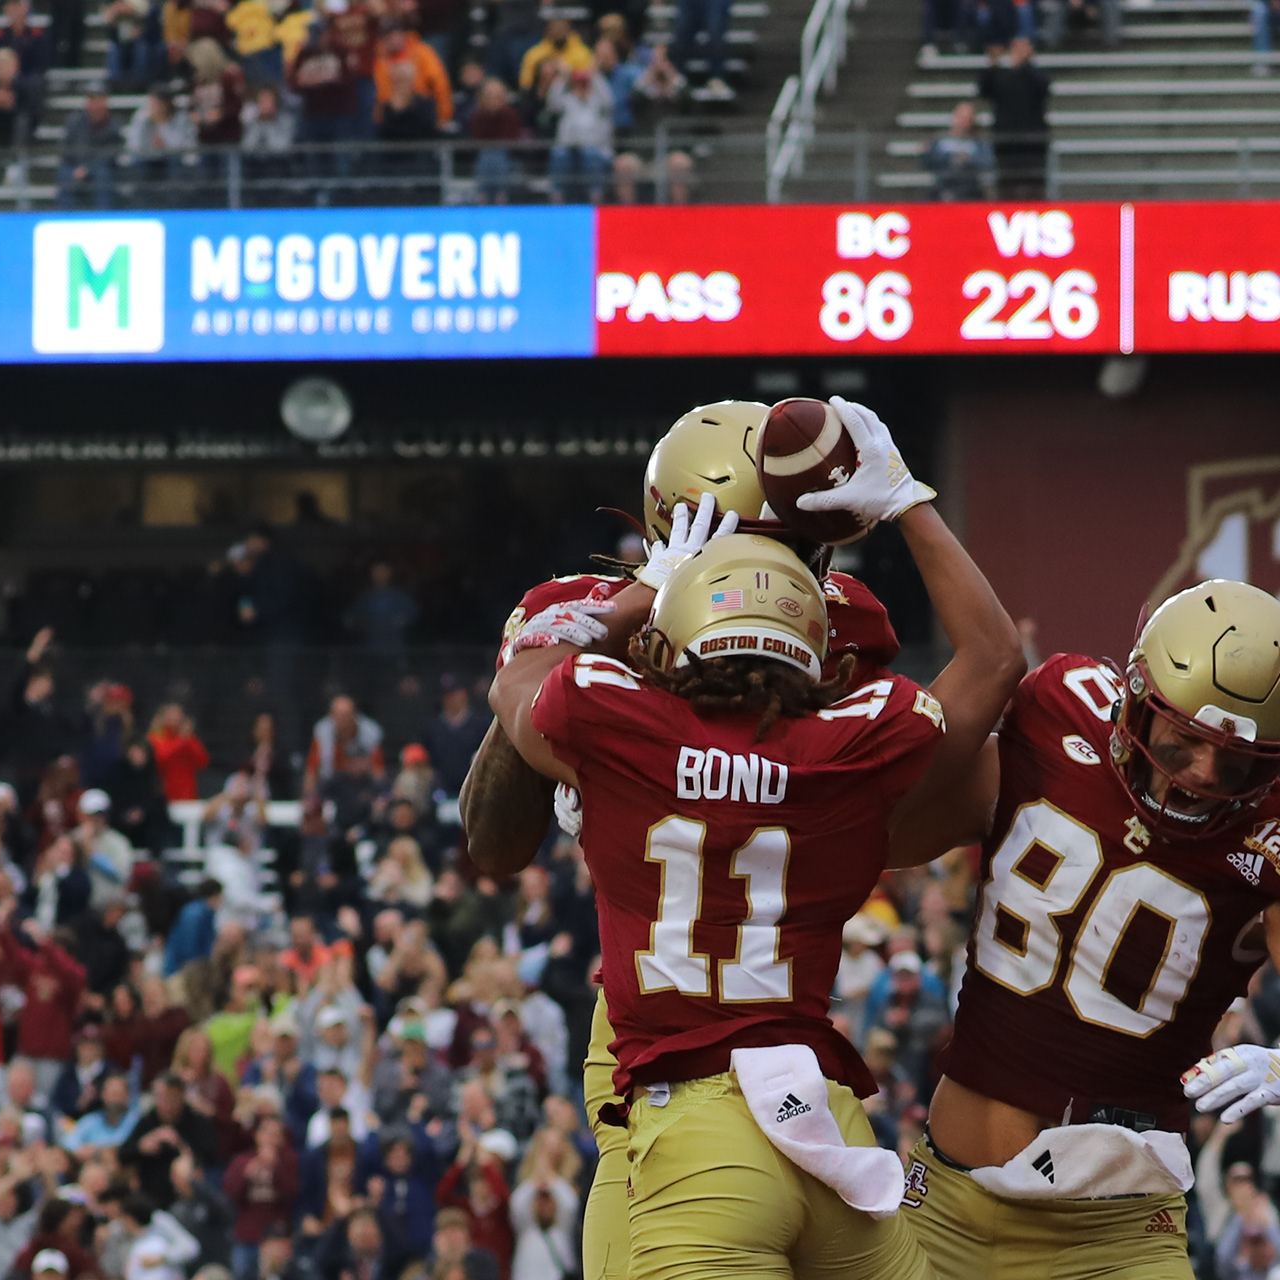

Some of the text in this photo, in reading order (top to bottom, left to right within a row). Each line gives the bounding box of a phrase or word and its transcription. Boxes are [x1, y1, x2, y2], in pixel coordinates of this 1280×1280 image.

[836, 210, 1074, 258] BC VIS
[67, 244, 131, 329] M
[191, 306, 519, 335] AUTOMOTIVE GROUP
[596, 270, 1099, 341] PASS 86 226
[755, 572, 770, 590] 11
[699, 635, 813, 669] BOSTON COLLEGE
[1068, 740, 1098, 761] ACC
[677, 746, 789, 803] BOND
[1226, 852, 1261, 886] adidas
[635, 814, 794, 1004] 11
[973, 799, 1213, 1039] 80
[776, 1103, 812, 1123] adidas
[1144, 1222, 1179, 1234] adidas
